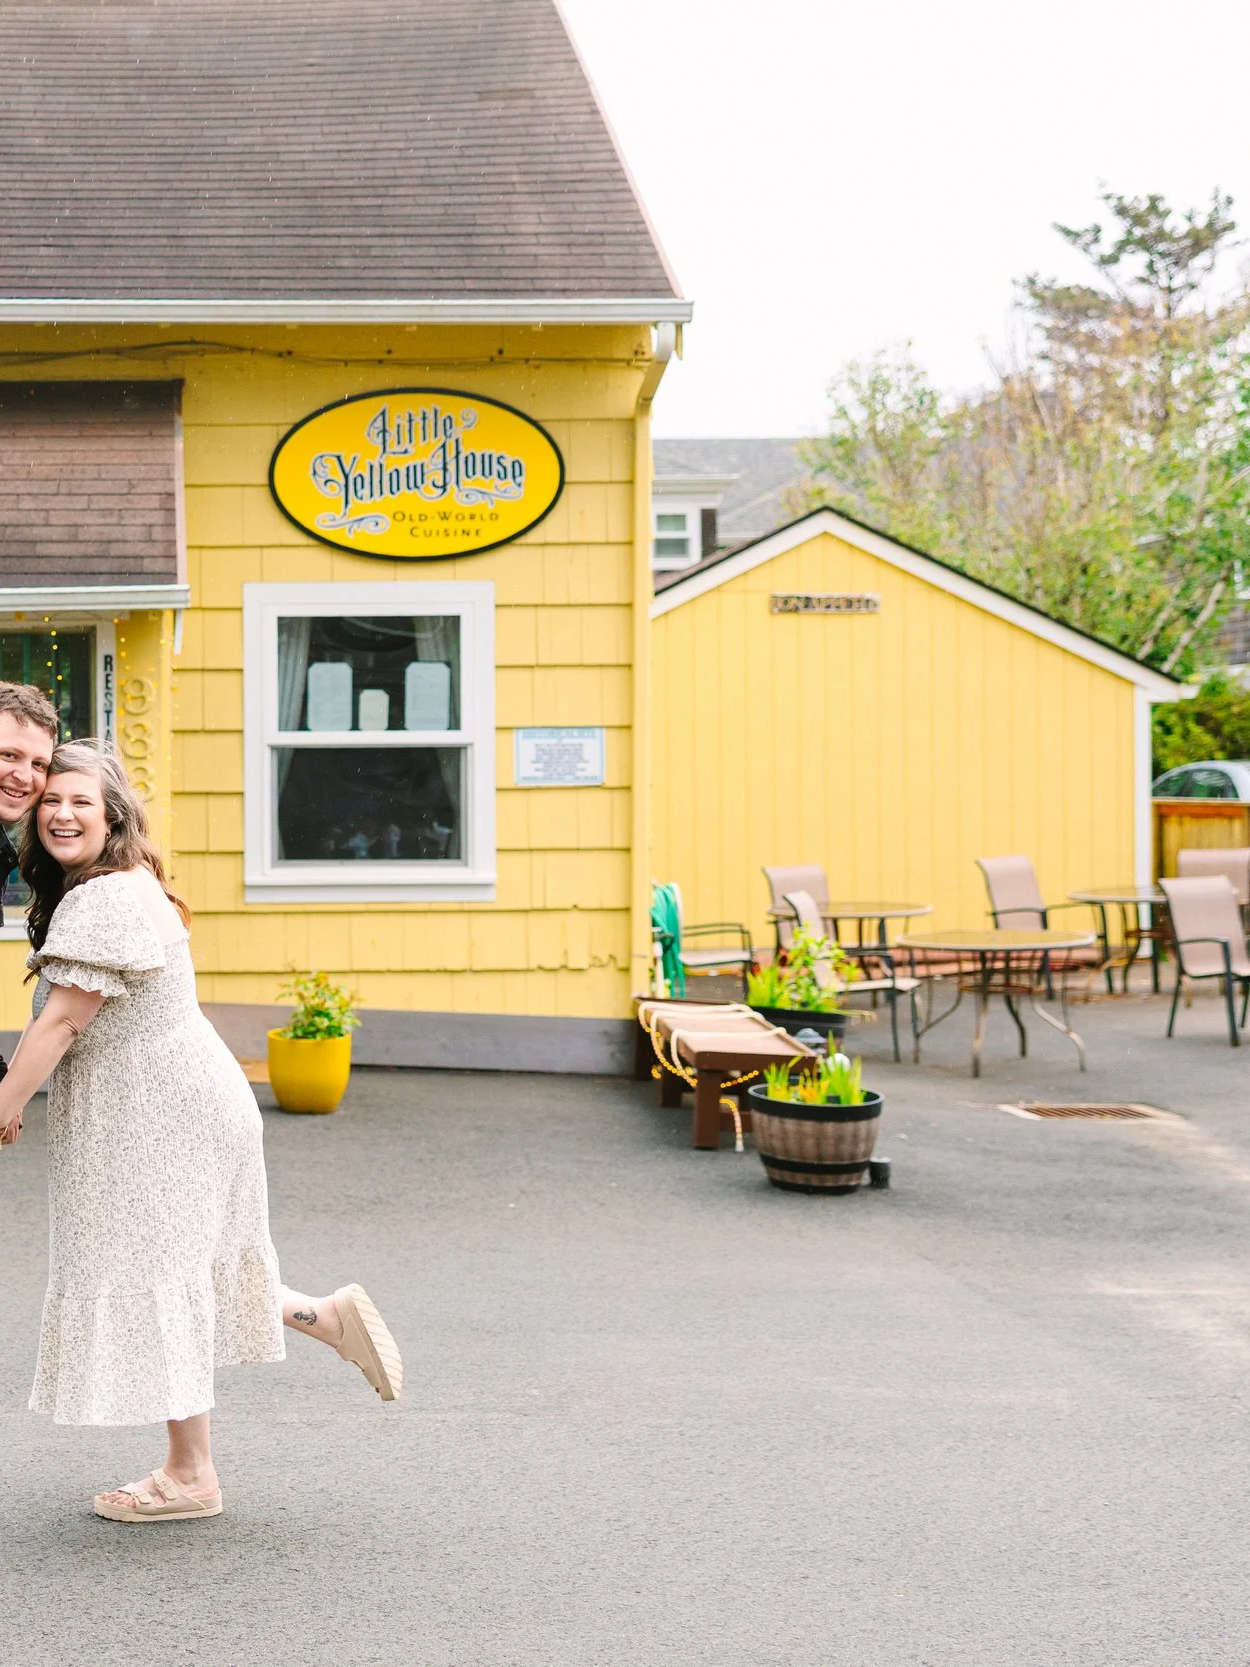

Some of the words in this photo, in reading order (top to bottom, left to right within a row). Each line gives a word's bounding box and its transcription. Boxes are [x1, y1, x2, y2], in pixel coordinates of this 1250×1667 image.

[367, 404, 477, 457] Little
[311, 453, 425, 522] Yellow
[421, 437, 525, 503] House
[409, 526, 482, 538] CUISINE
